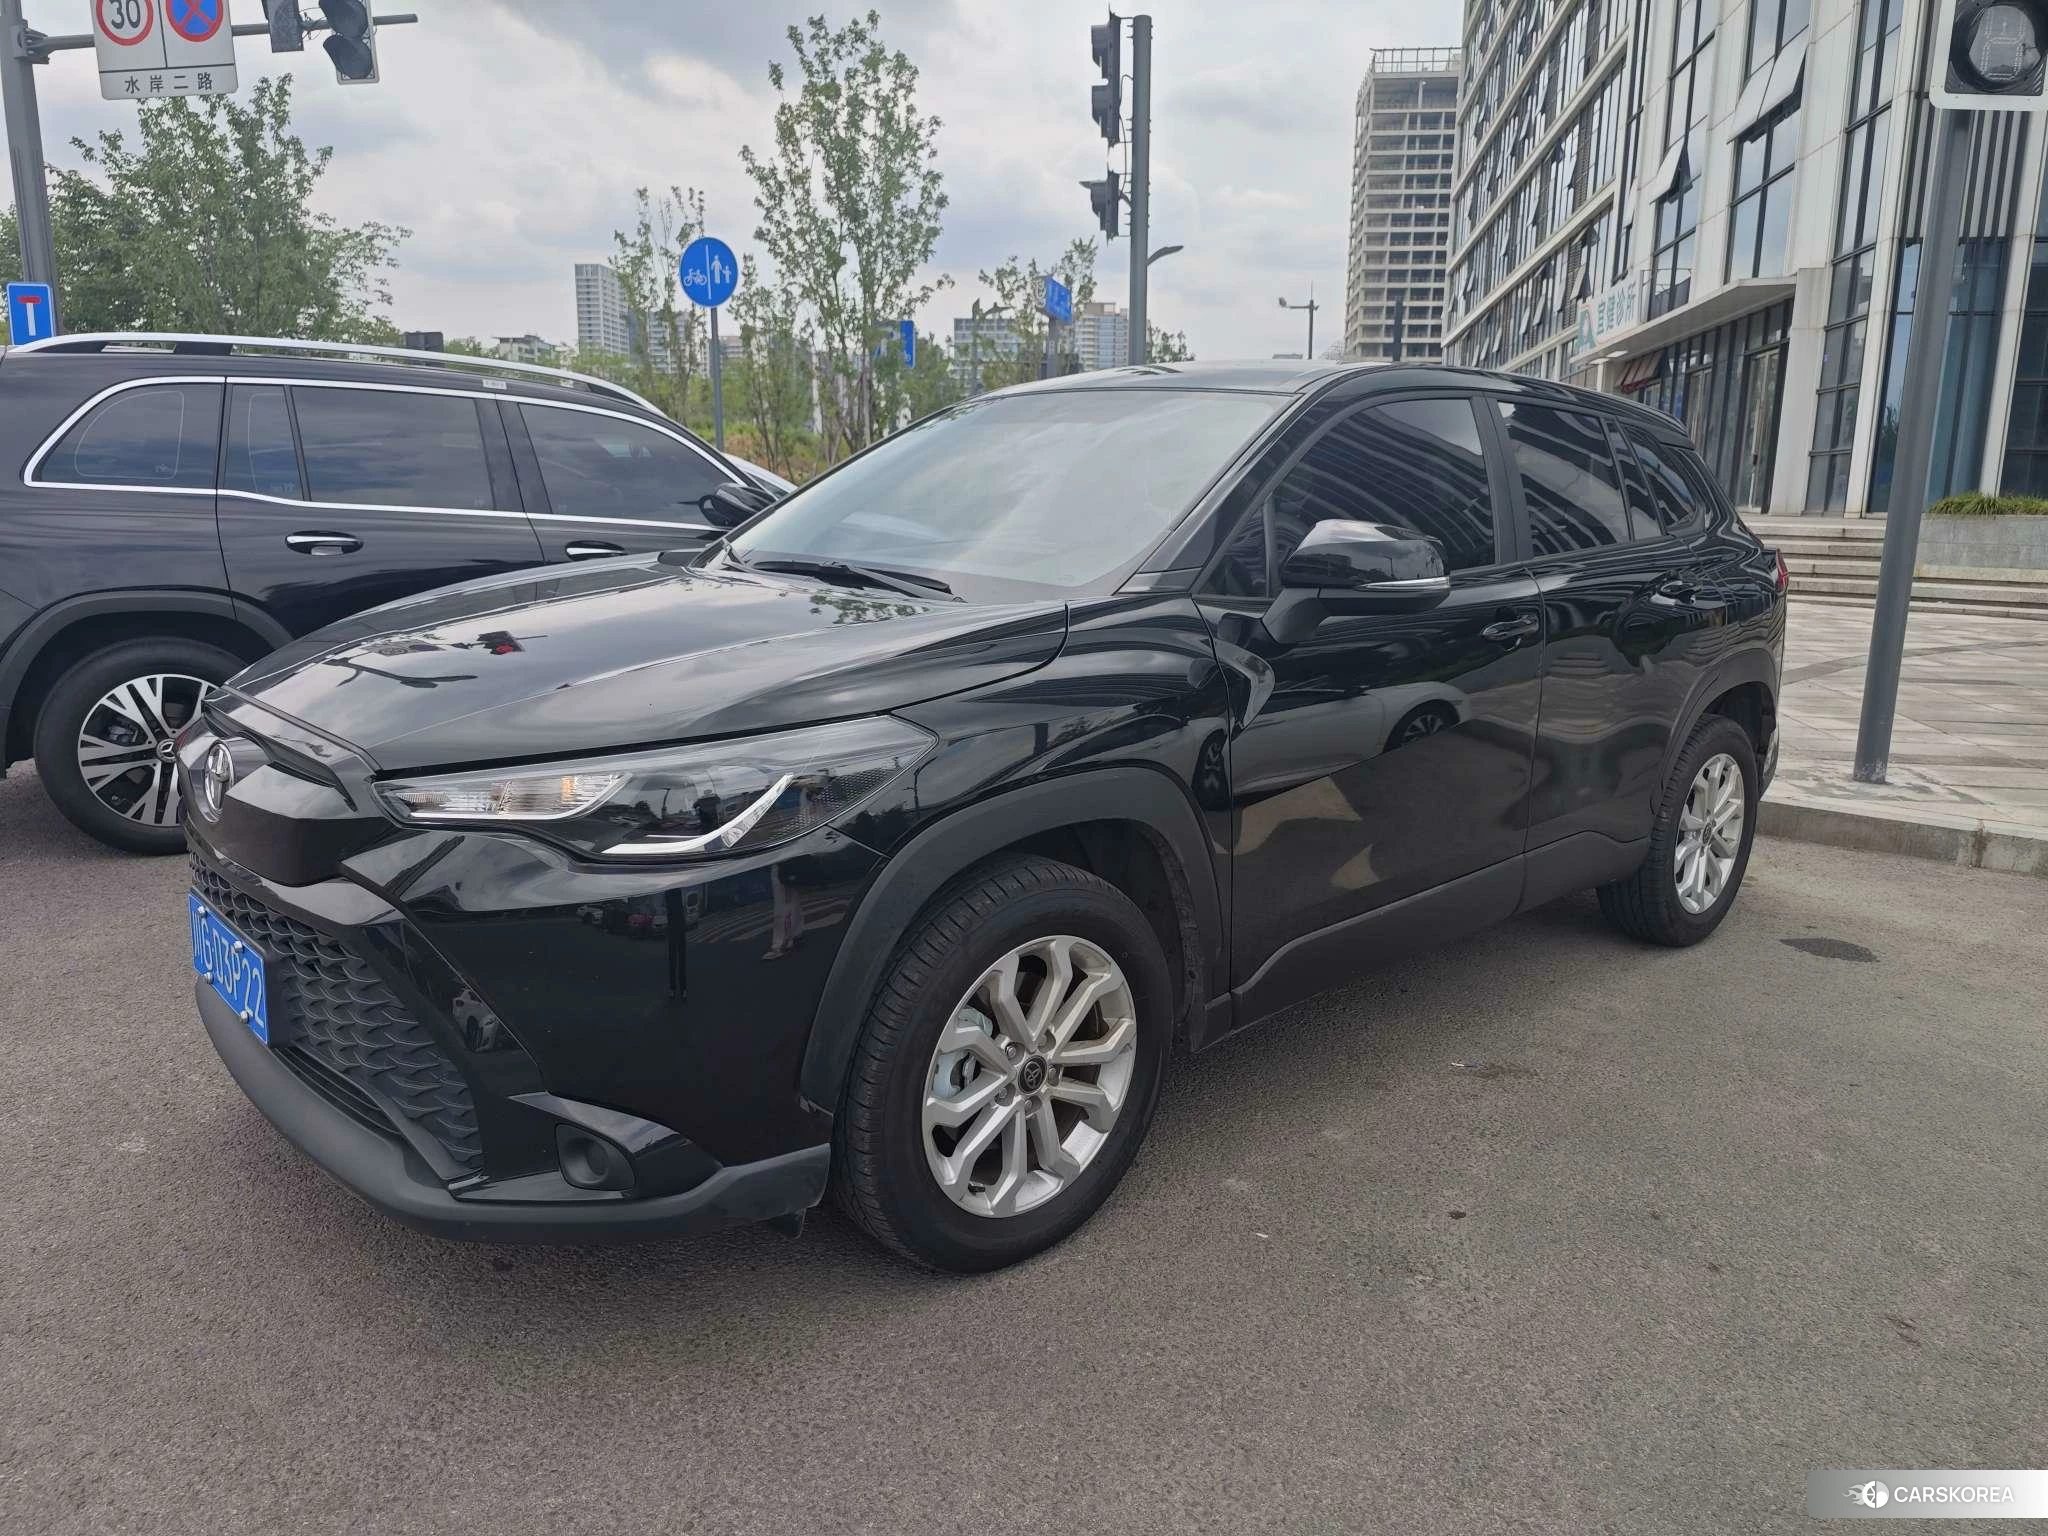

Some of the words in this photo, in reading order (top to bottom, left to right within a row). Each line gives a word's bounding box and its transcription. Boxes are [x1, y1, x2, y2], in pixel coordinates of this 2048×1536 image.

[110, 0, 141, 29] 30
[124, 72, 213, 94] 水岸二路
